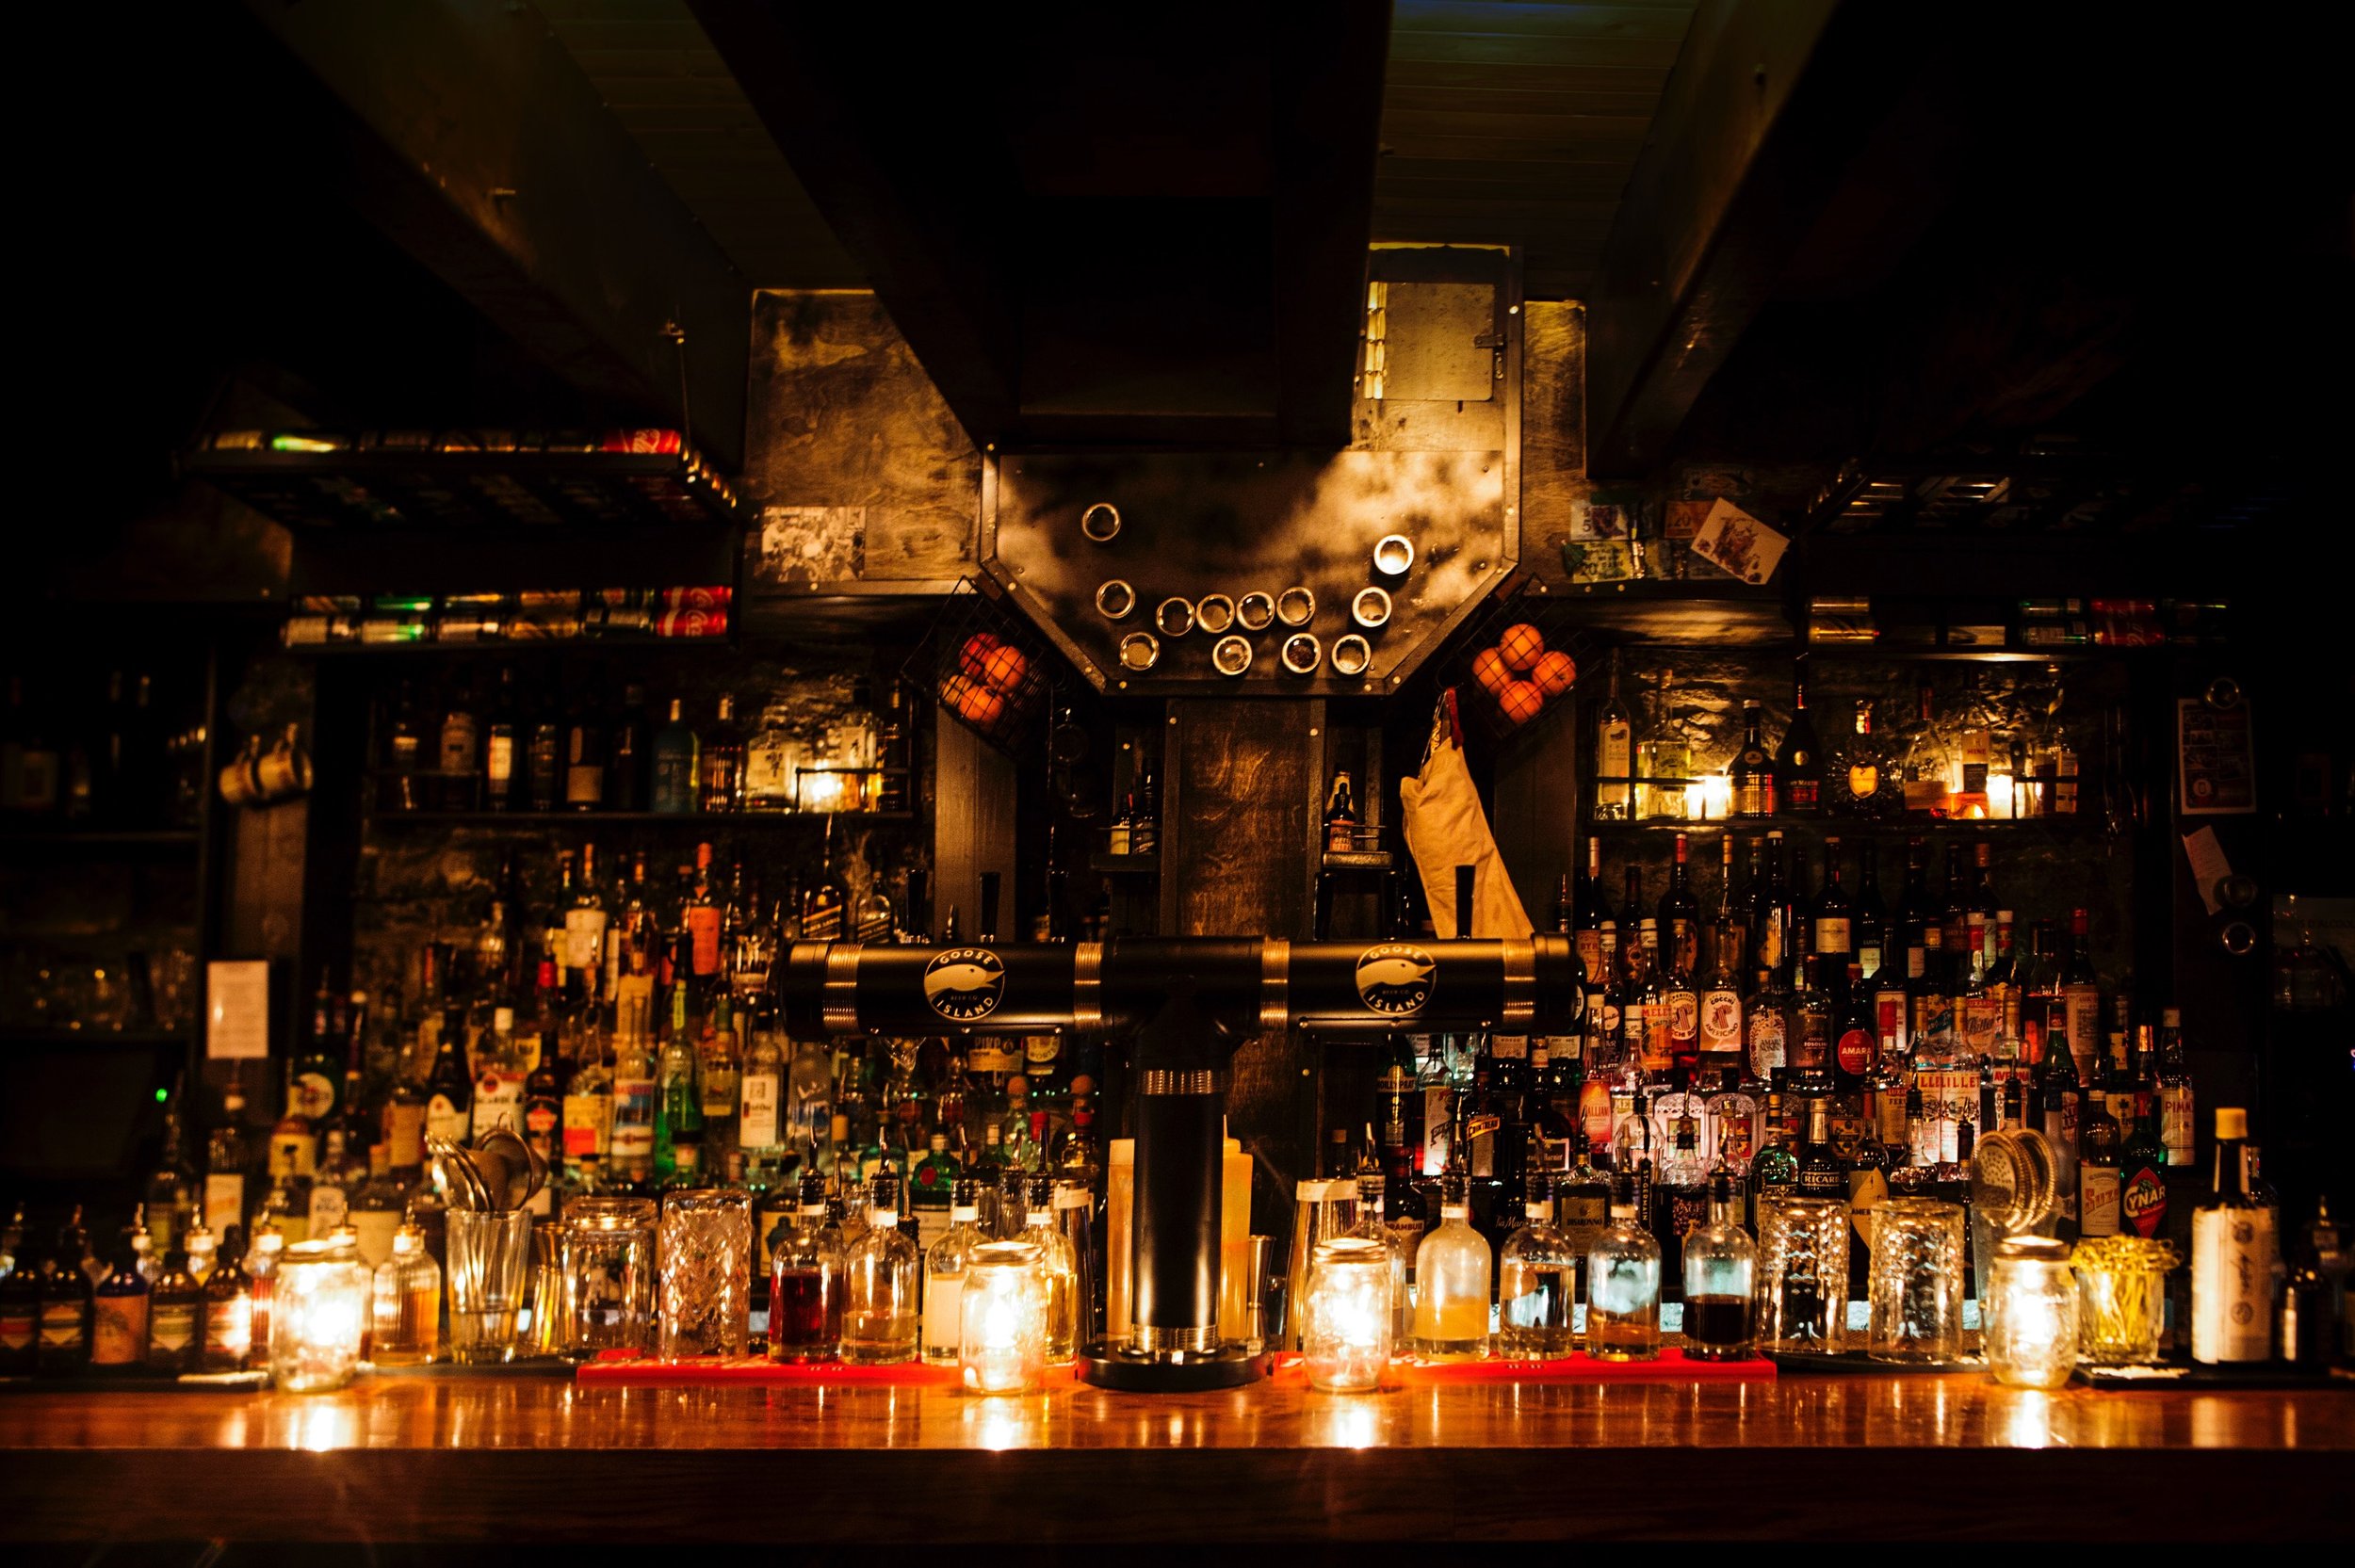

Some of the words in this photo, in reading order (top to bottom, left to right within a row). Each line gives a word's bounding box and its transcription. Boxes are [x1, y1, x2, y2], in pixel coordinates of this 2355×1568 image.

[939, 949, 994, 964] GOOSE
[1370, 946, 1424, 960] GOOSE
[935, 996, 994, 1017] ISLAND
[1367, 991, 1425, 1012] ISLAND
[1711, 996, 1734, 1005] COCCHI
[1642, 1009, 1671, 1017] MELE
[2166, 1100, 2194, 1113] PIMM
[2123, 1185, 2166, 1218] CYNAR
